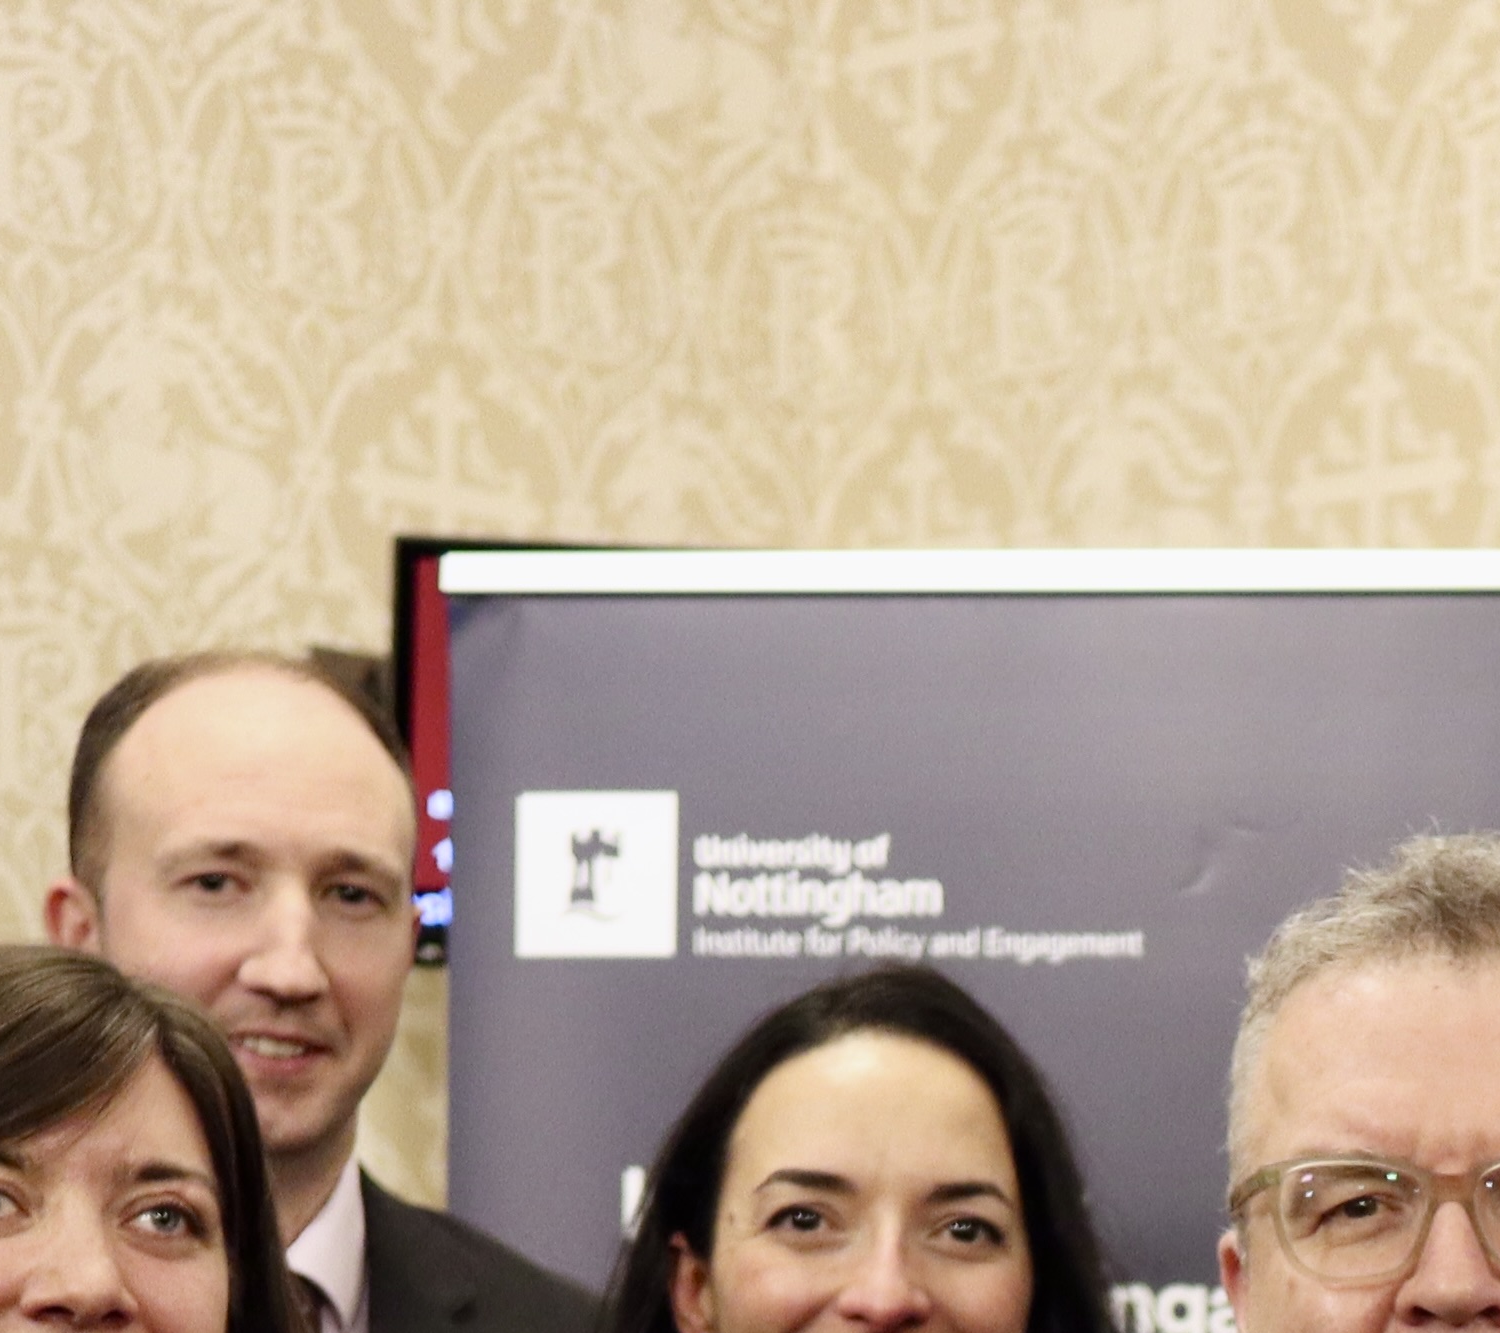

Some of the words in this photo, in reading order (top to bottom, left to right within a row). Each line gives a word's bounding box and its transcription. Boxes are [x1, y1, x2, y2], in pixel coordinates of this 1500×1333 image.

[694, 832, 852, 875] University
[853, 832, 892, 869] of
[694, 870, 944, 927] Nottingham
[694, 925, 801, 957] Institute
[804, 924, 843, 957] for
[845, 926, 928, 960] Policy
[928, 926, 980, 957] and
[981, 926, 1145, 965] Engagement
